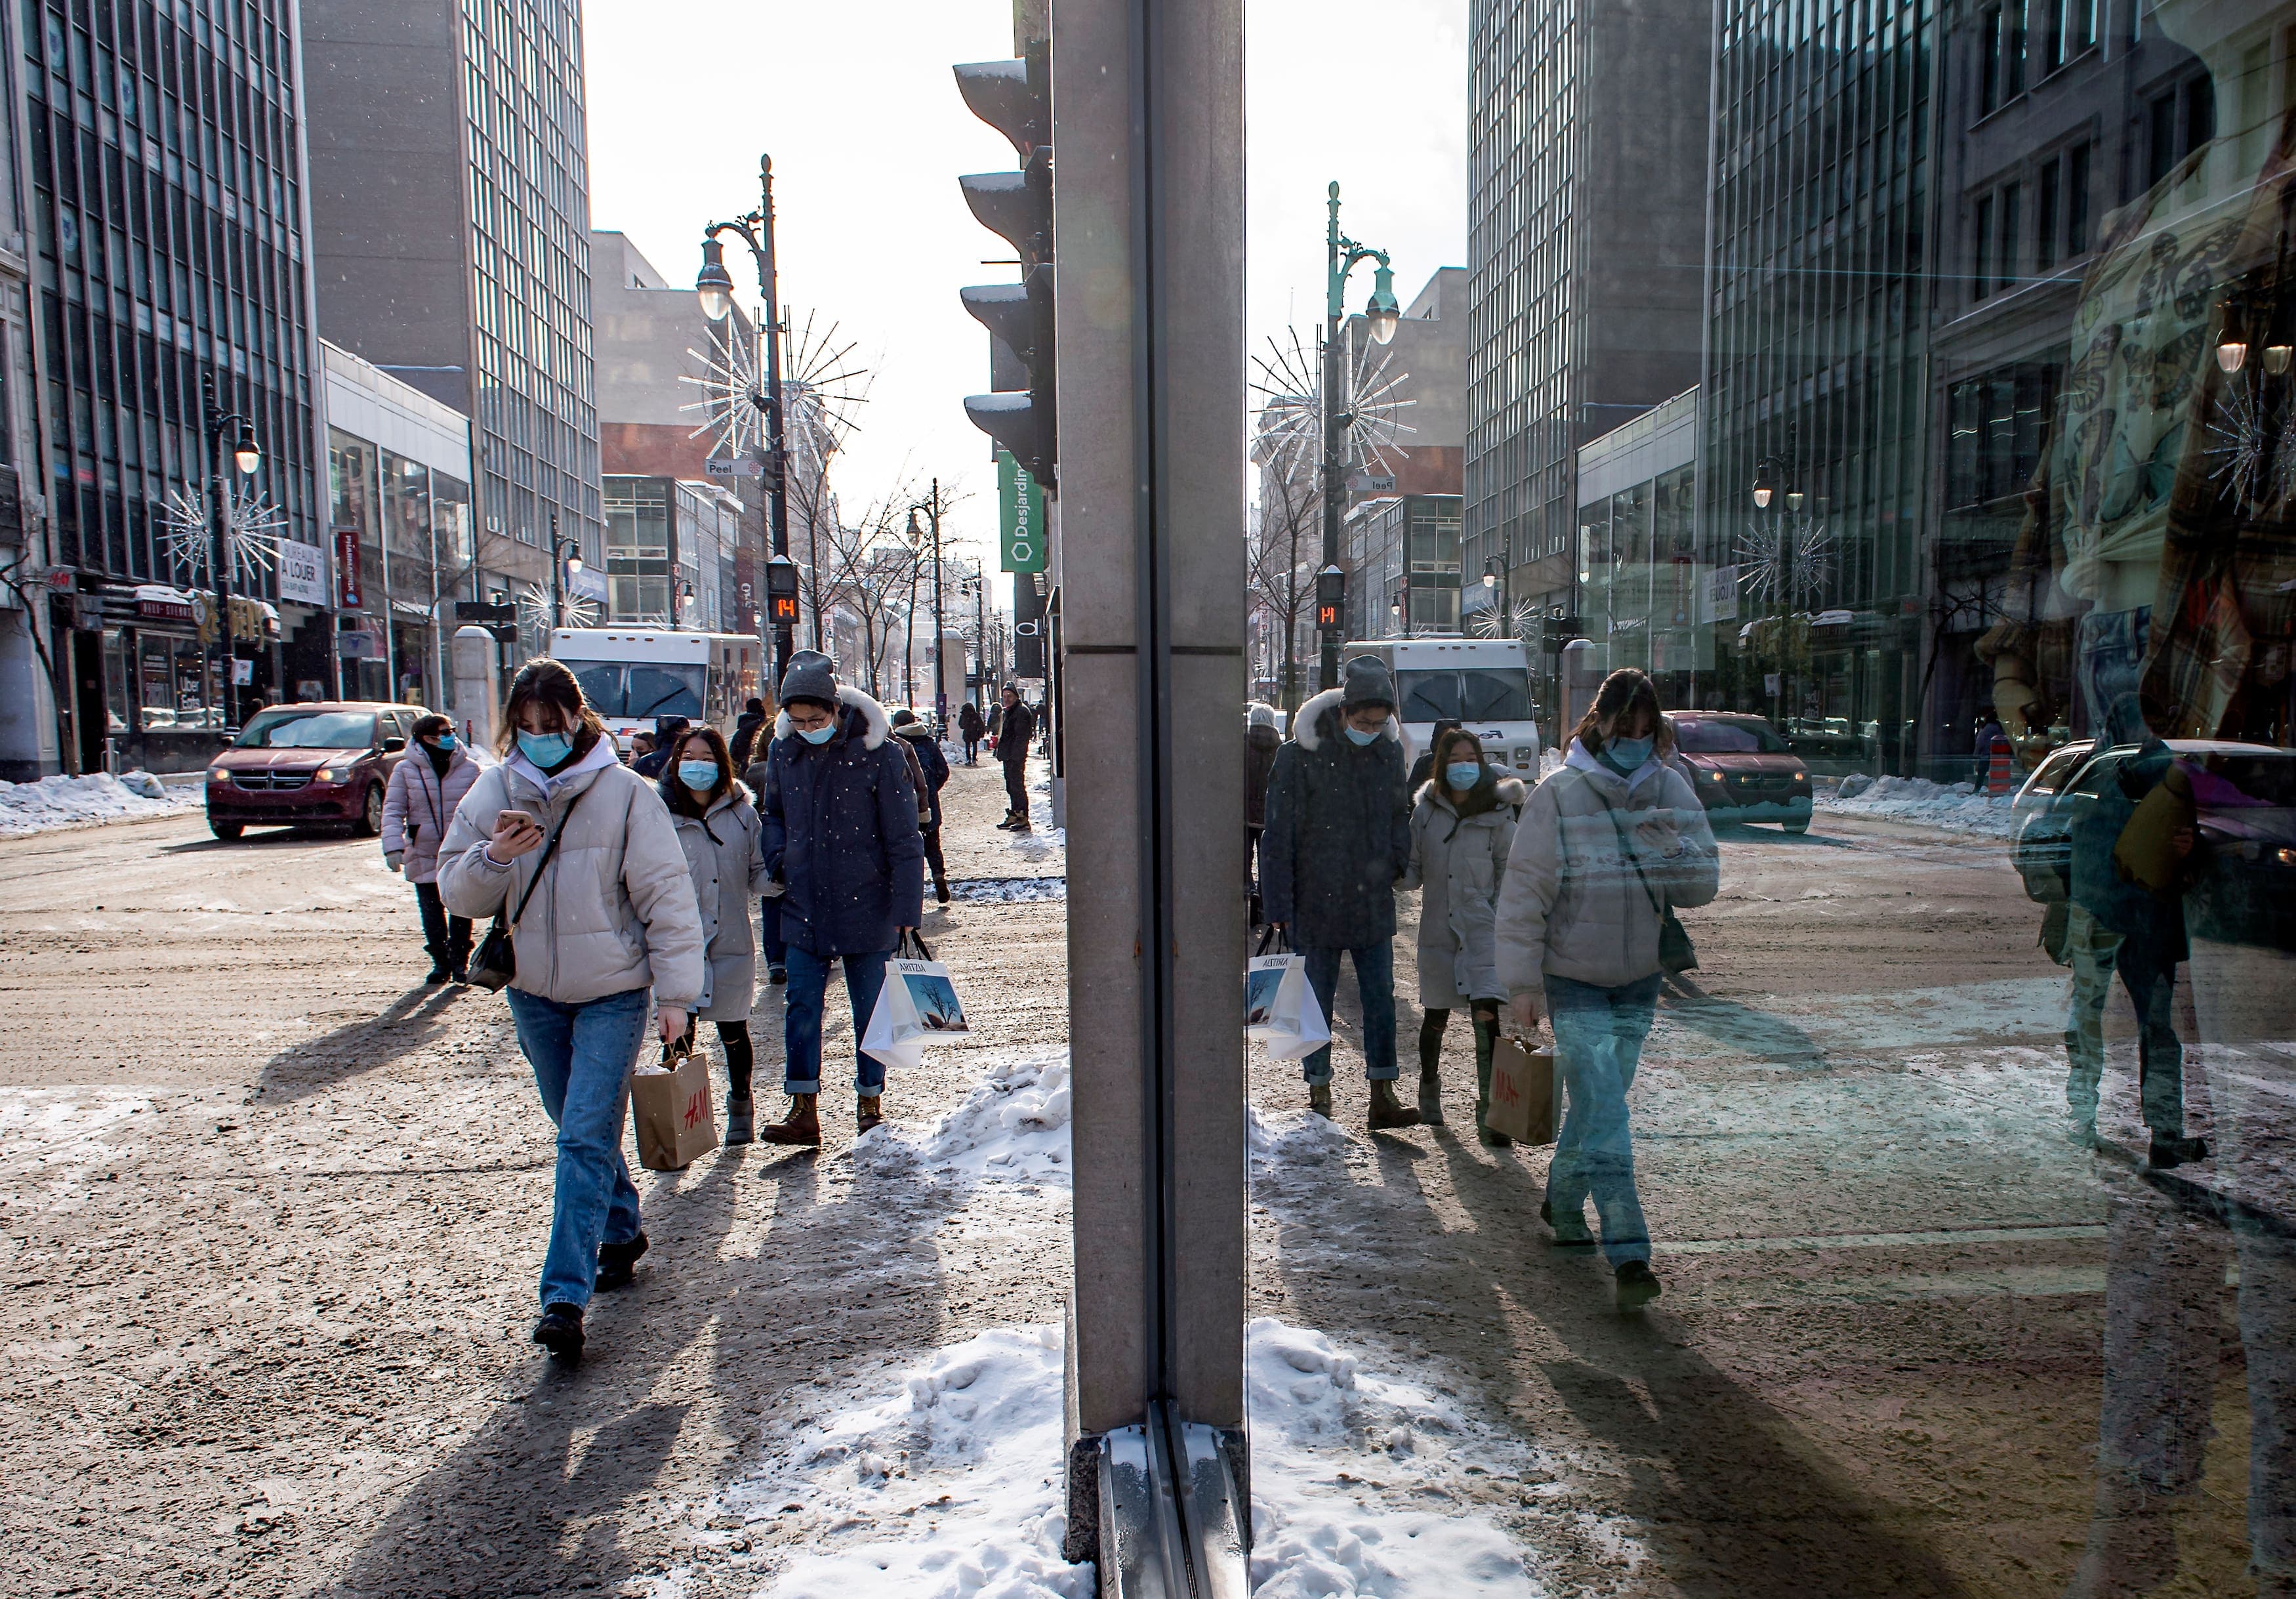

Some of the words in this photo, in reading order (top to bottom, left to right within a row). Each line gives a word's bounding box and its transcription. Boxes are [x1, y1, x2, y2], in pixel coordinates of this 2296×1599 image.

[709, 465, 731, 473] Peel
[291, 561, 316, 583] LOUER
[778, 599, 794, 617] 14
[180, 676, 199, 692] Uber
[181, 694, 200, 709] Eats
[899, 963, 926, 972] ARITZIA
[684, 1086, 708, 1131] H&M
